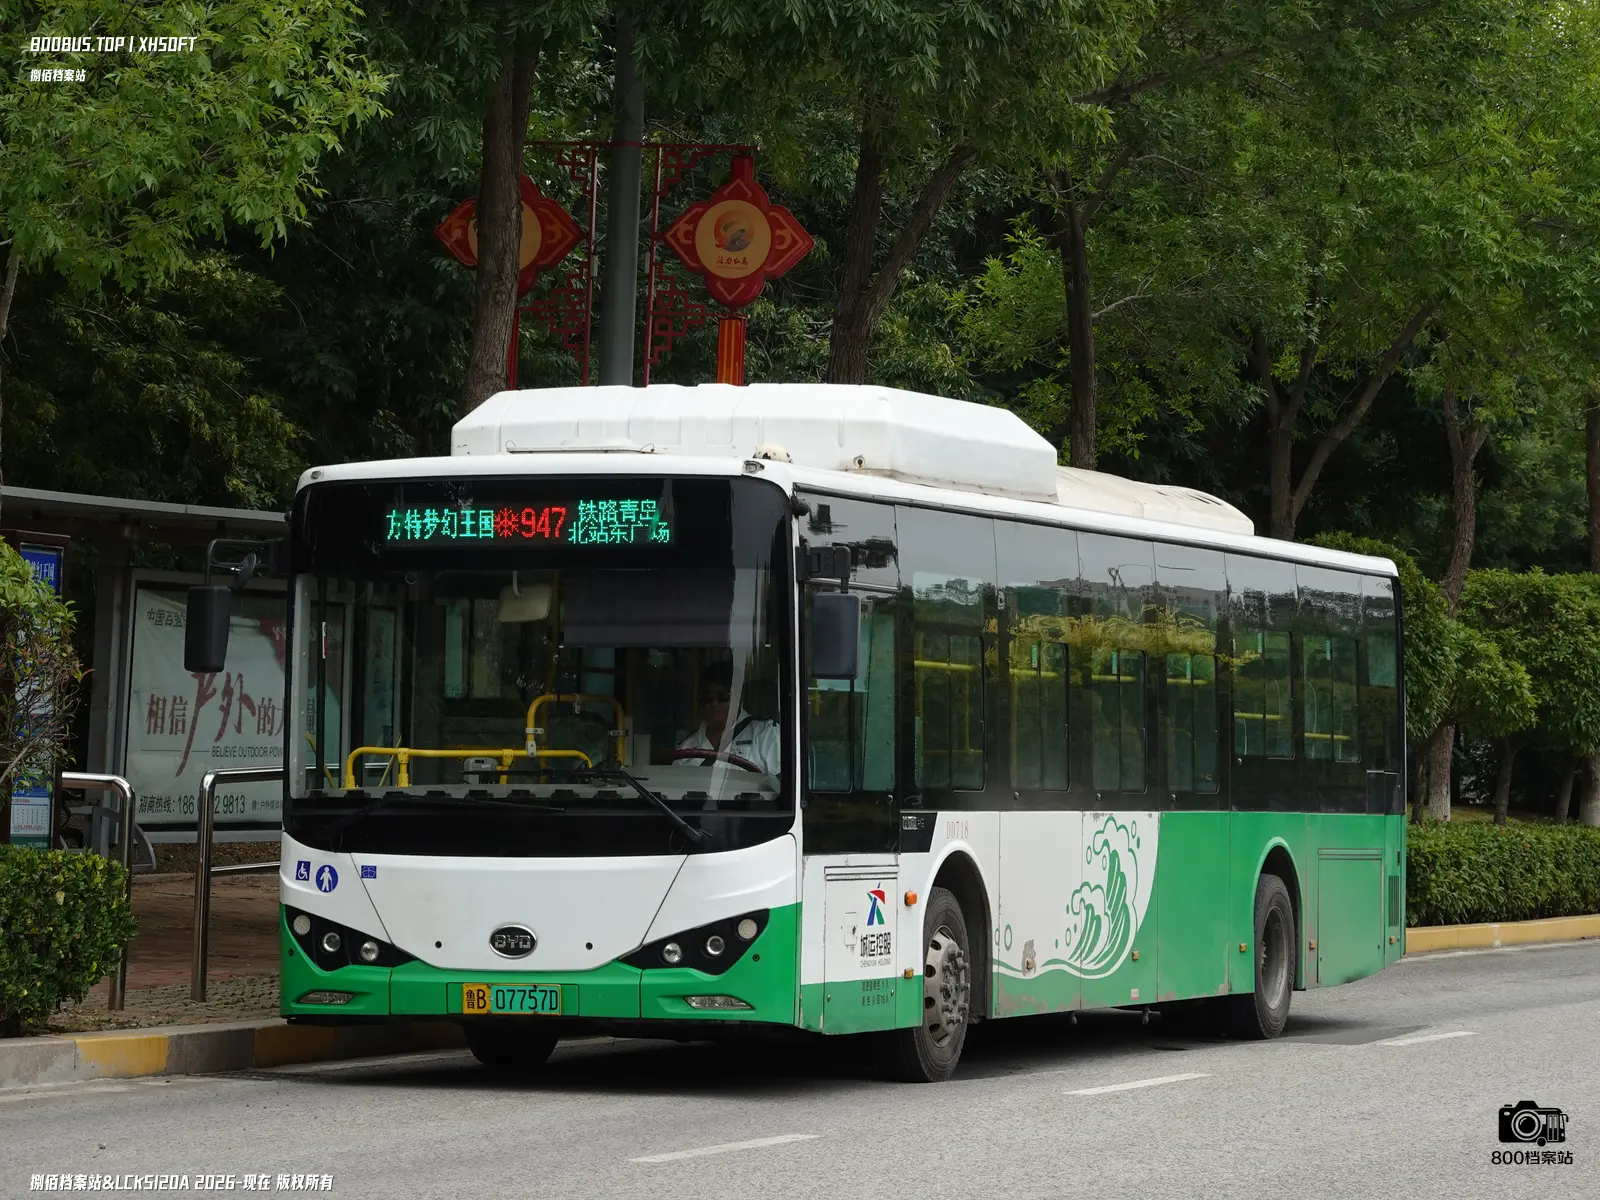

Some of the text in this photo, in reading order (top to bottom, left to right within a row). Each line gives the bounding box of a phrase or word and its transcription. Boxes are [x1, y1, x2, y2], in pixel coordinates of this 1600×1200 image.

[521, 506, 567, 538] 947
[578, 499, 657, 523] 铁路青岛
[386, 508, 494, 540] 方特梦幻王国
[568, 521, 670, 544] 北站东广场
[212, 746, 237, 758] BELIEVE
[238, 746, 268, 758] OUTDOOR
[223, 794, 246, 814] 9813
[494, 934, 532, 949] BYD
[860, 932, 891, 957] 城运控股
